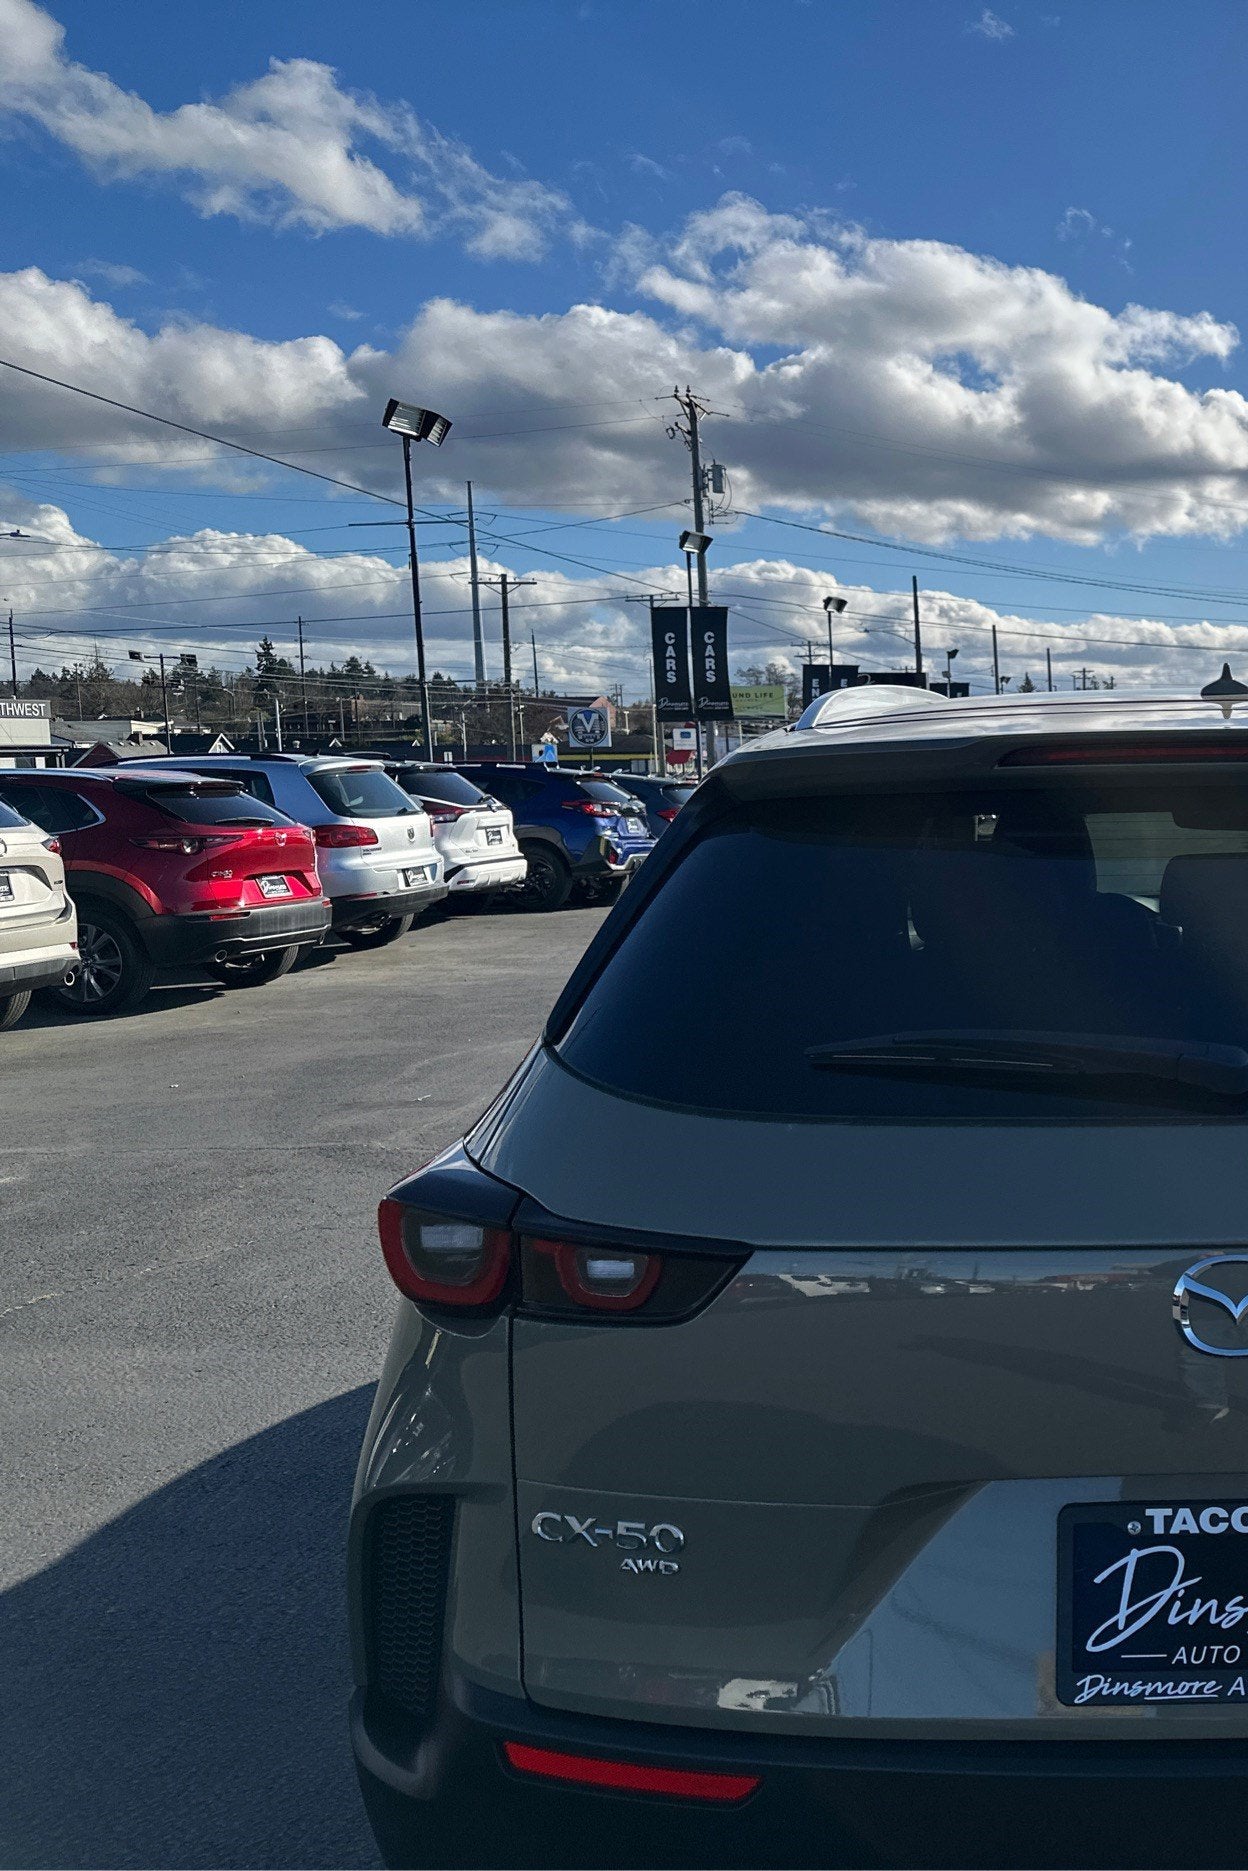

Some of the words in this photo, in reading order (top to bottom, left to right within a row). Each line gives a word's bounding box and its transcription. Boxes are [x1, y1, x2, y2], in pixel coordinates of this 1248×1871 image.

[664, 632, 677, 683] CARS
[704, 631, 716, 683] CARS
[531, 1511, 685, 1554] CX-50
[620, 1558, 680, 1575] AWD
[1171, 1645, 1241, 1665] AUTO
[1074, 1674, 1222, 1704] Dinsmore
